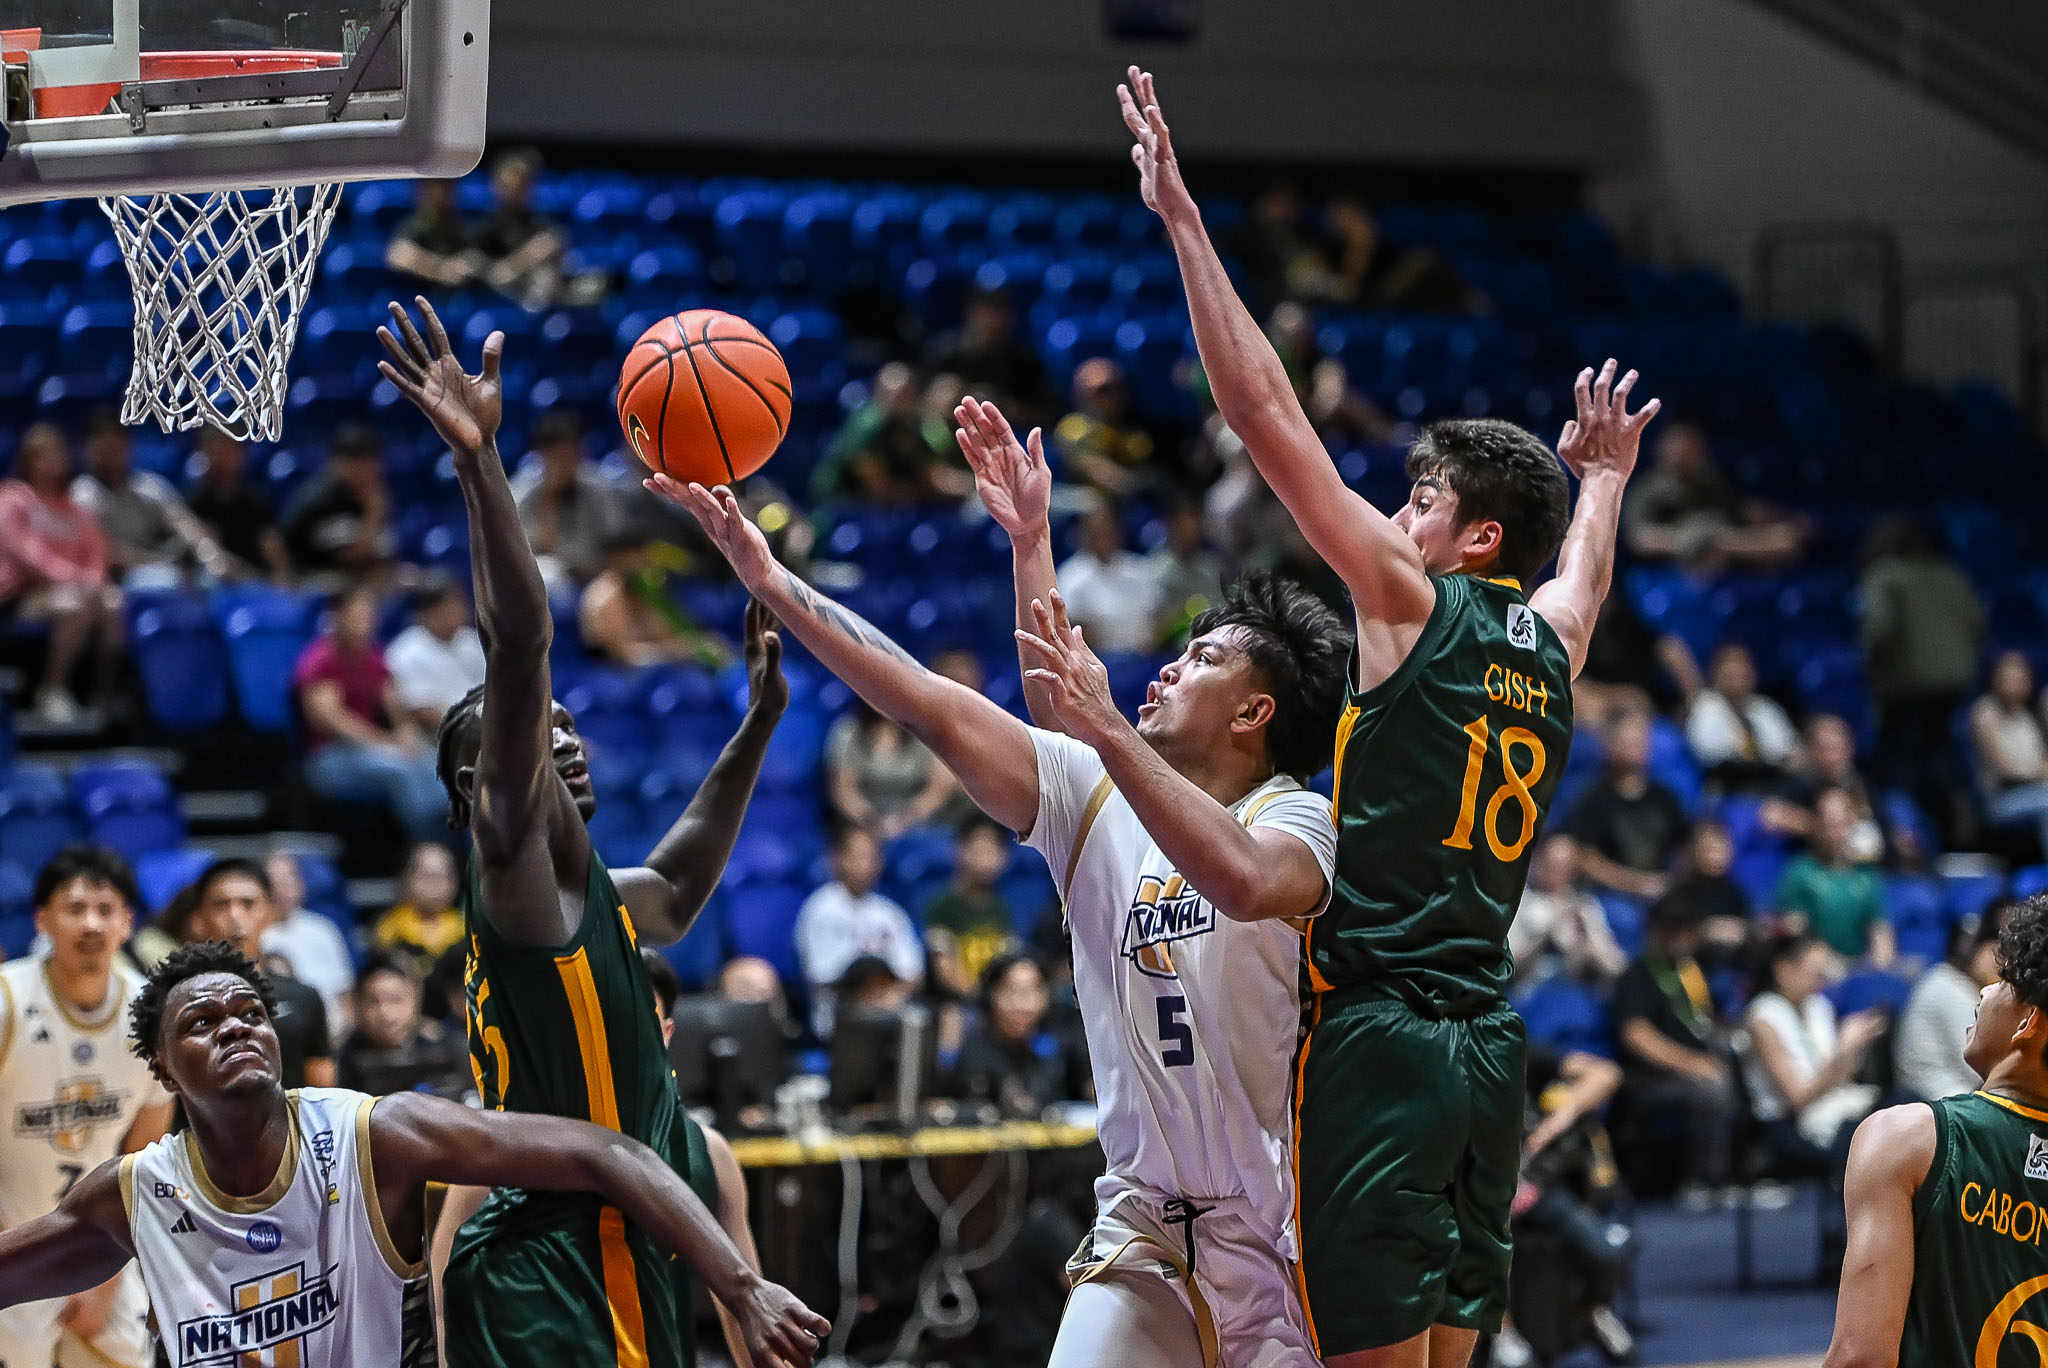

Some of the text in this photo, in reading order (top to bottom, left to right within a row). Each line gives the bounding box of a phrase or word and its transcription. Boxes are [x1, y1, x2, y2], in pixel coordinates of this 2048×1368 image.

[1484, 663, 1548, 718] GISH
[1442, 714, 1546, 862] 18
[1156, 995, 1195, 1068] 5
[186, 1279, 340, 1357] NATIONAL
